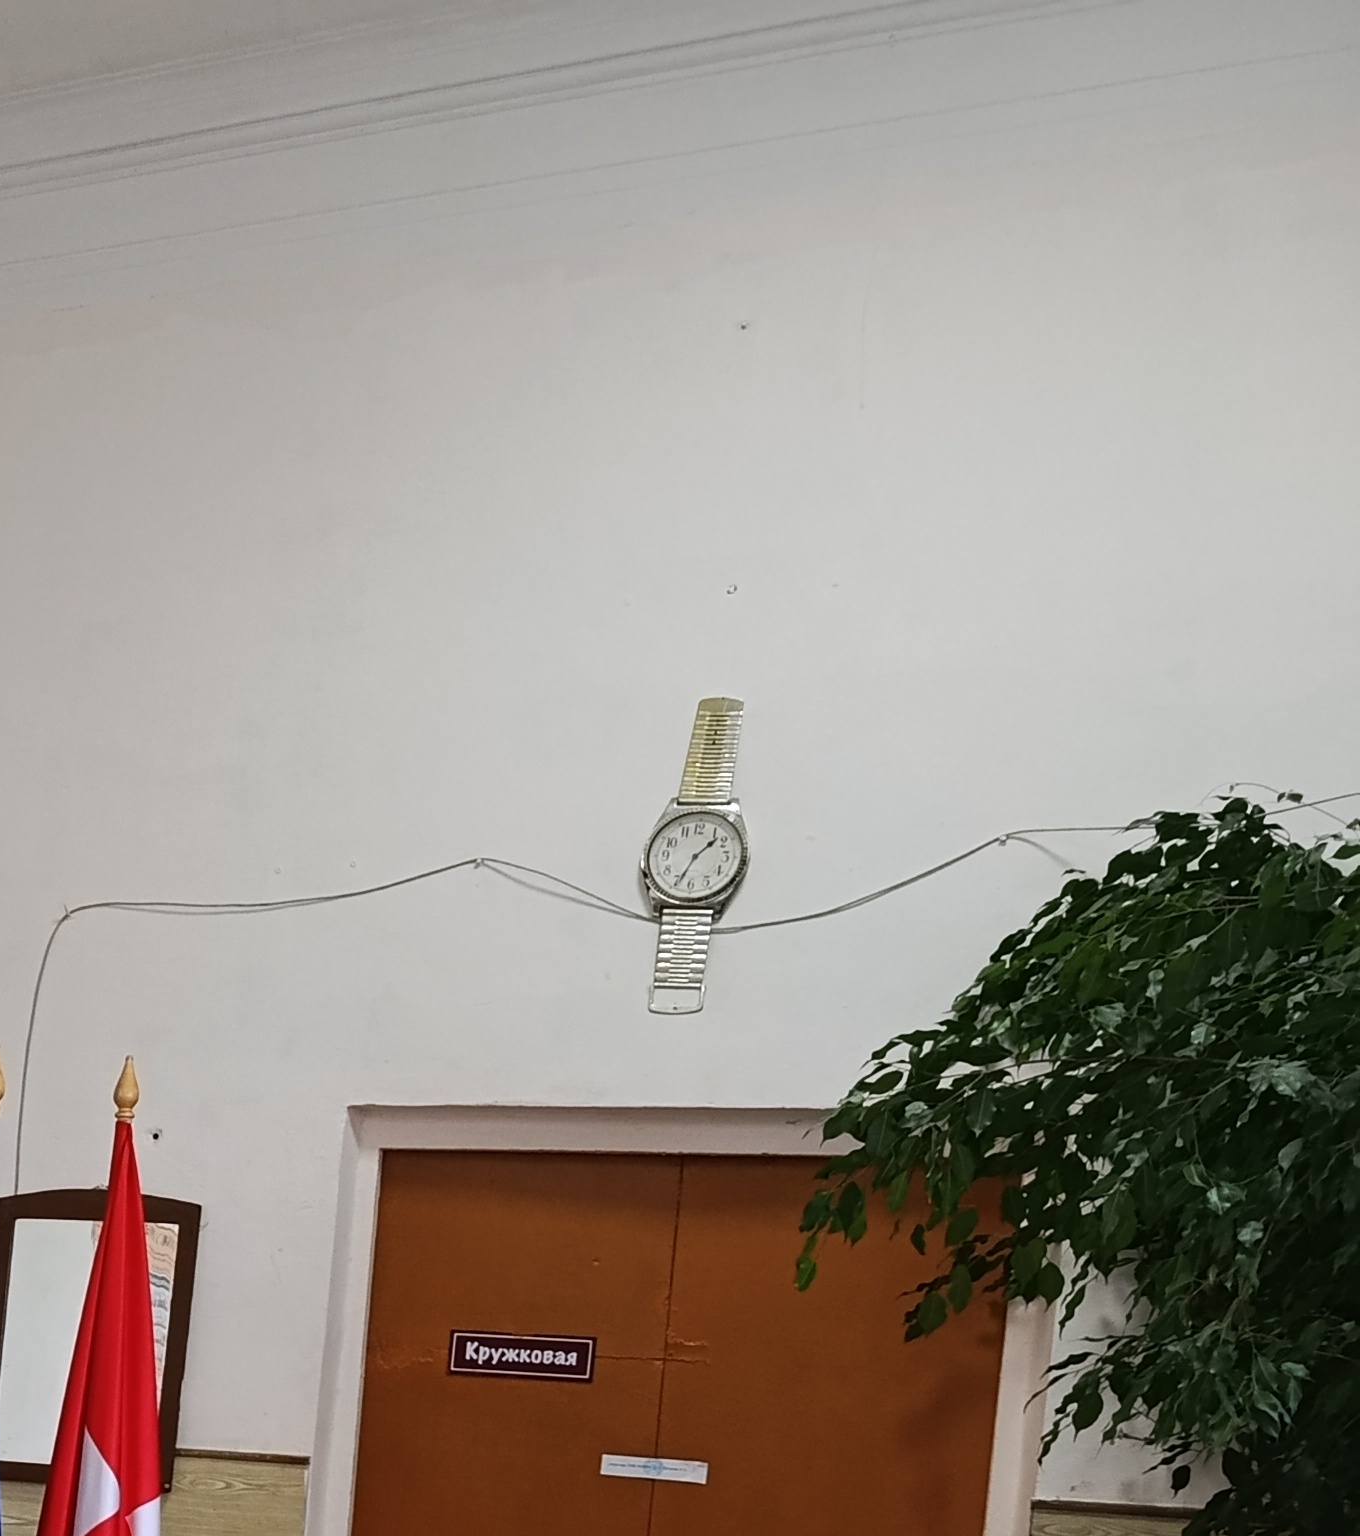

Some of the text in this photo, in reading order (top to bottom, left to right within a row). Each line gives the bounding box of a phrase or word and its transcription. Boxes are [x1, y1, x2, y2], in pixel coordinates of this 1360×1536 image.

[693, 823, 706, 835] 12
[666, 836, 678, 848] 10
[719, 835, 728, 848] 2
[661, 849, 670, 862] 9
[662, 864, 672, 876] 8
[686, 879, 695, 890] 6
[464, 1340, 579, 1367] Кружковая
